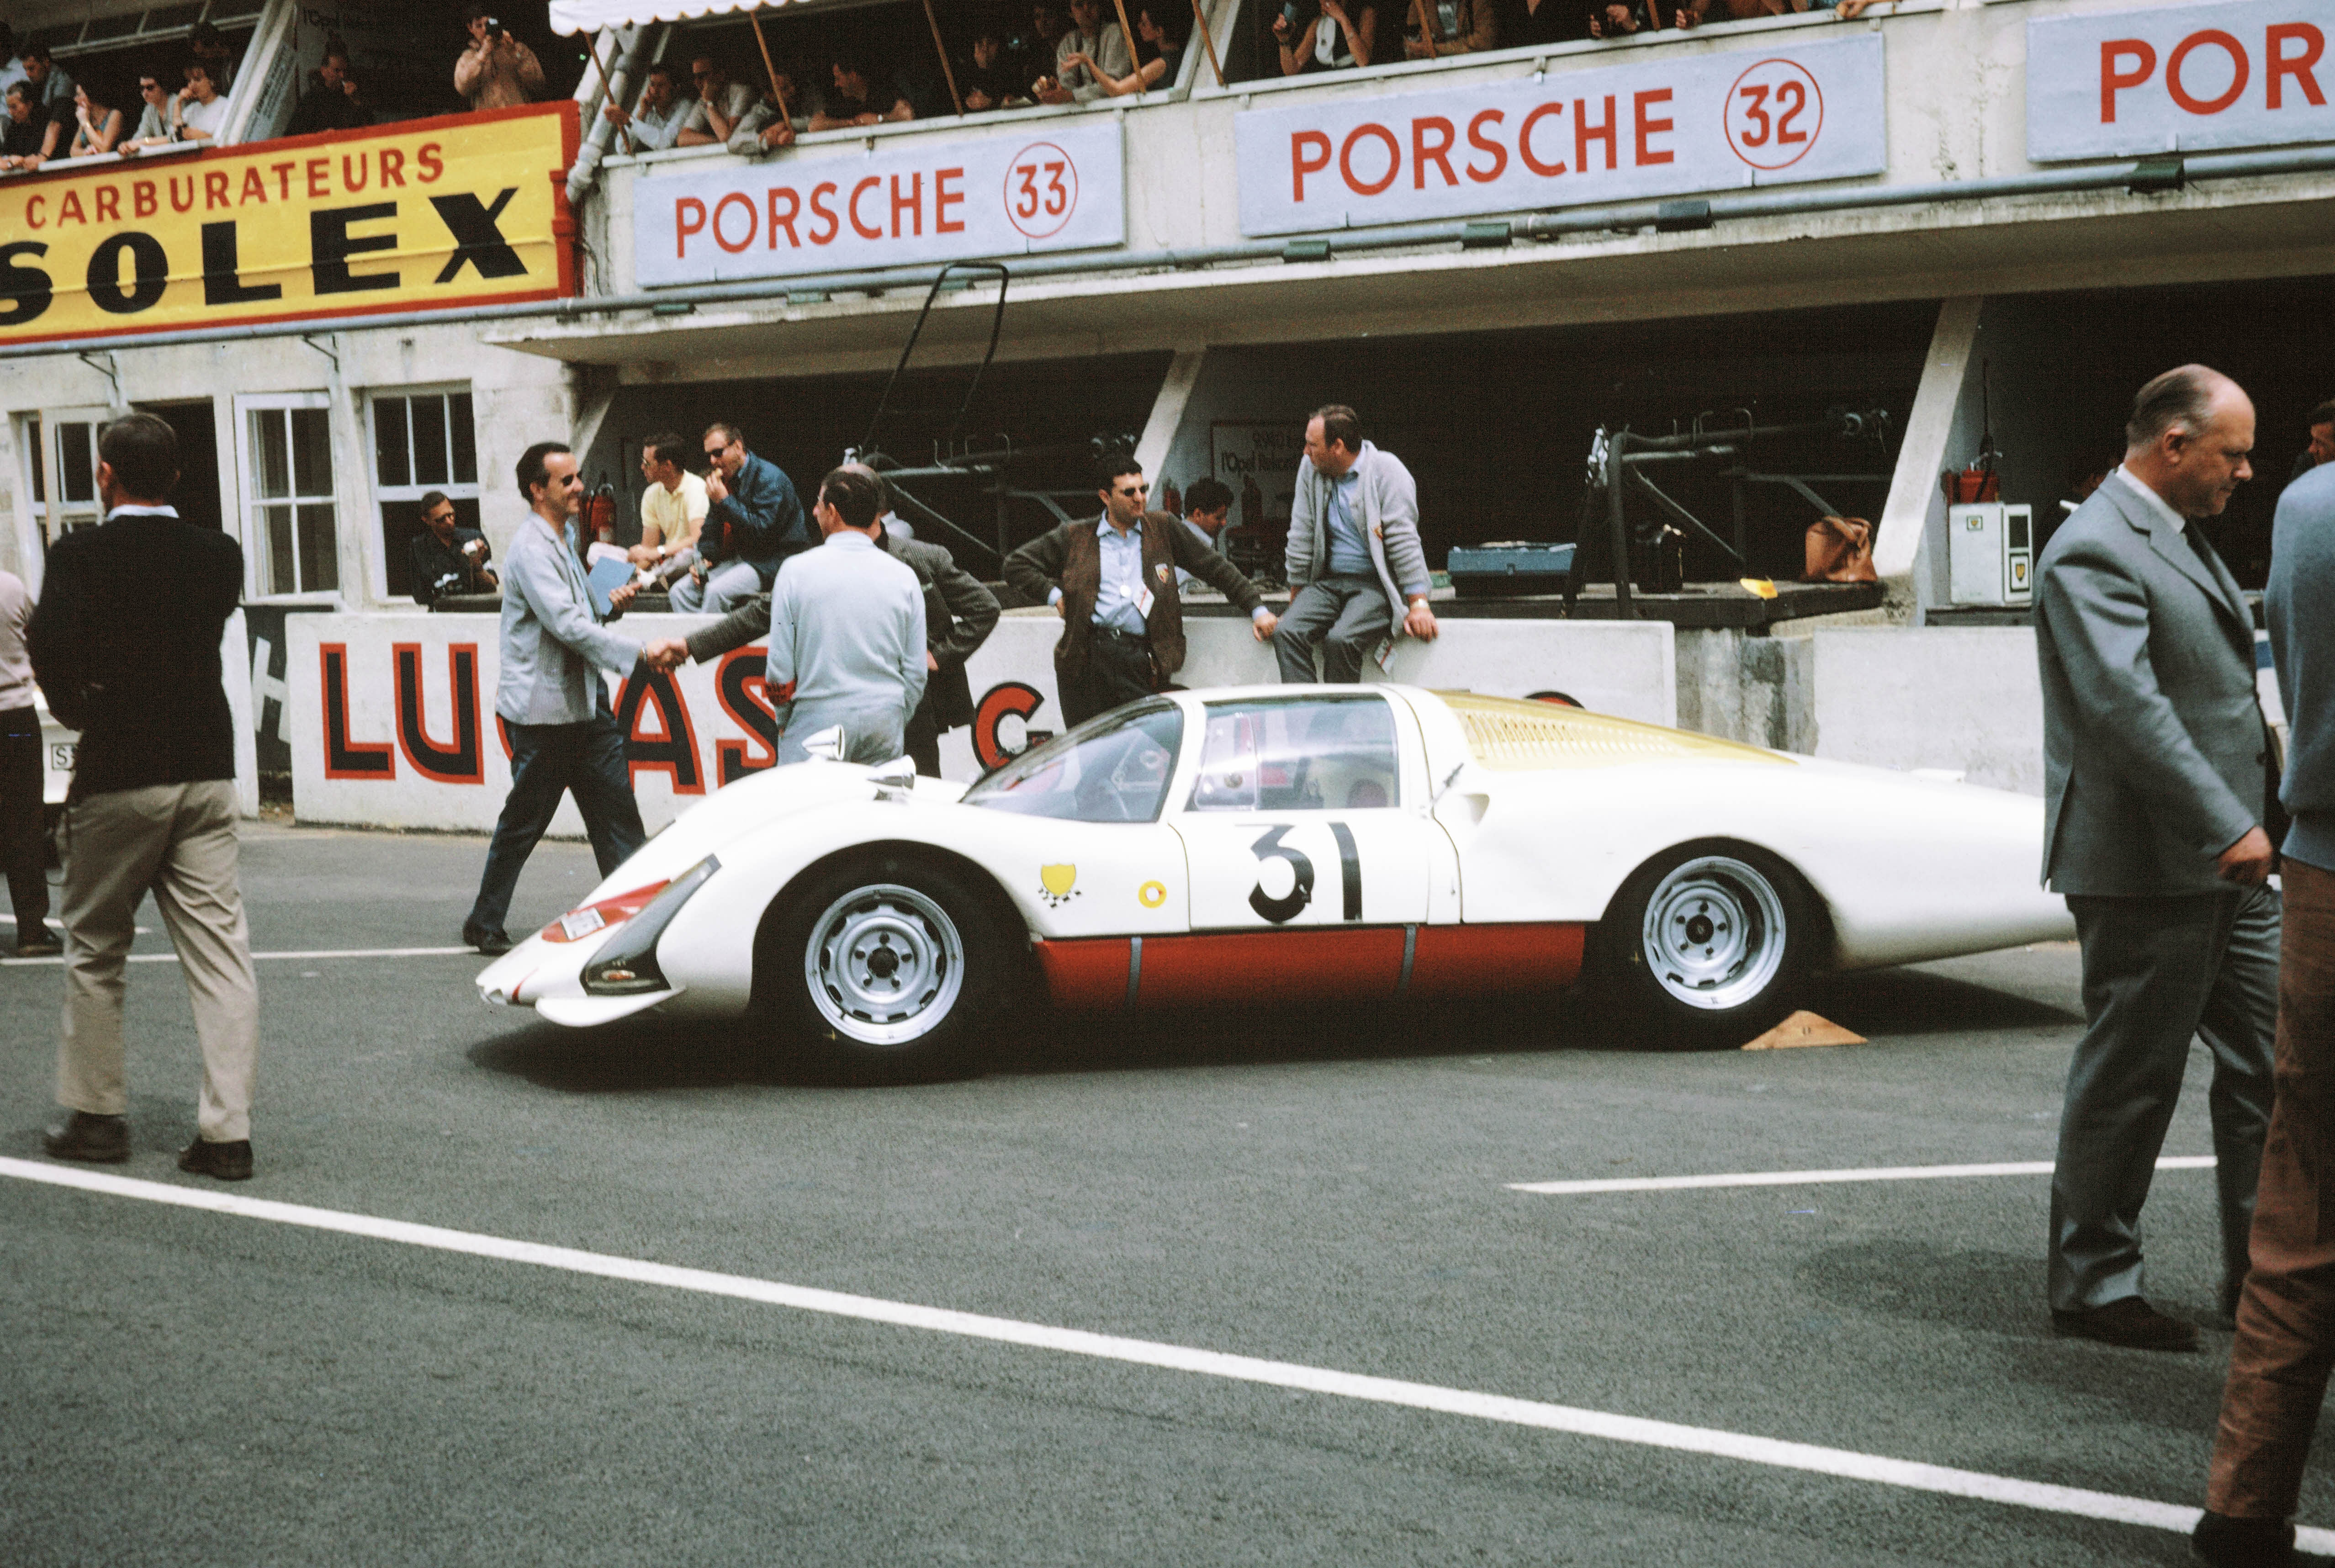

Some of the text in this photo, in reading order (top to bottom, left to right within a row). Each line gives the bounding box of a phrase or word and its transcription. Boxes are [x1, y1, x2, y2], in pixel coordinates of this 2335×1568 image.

[26, 142, 444, 229] CARBURATEURS
[1292, 79, 1807, 202] PORSCHE 32
[0, 187, 529, 326] SOLEX
[676, 161, 1067, 258] PORSCHE 33
[319, 642, 778, 795] LUAS
[1244, 822, 1364, 923] 31
